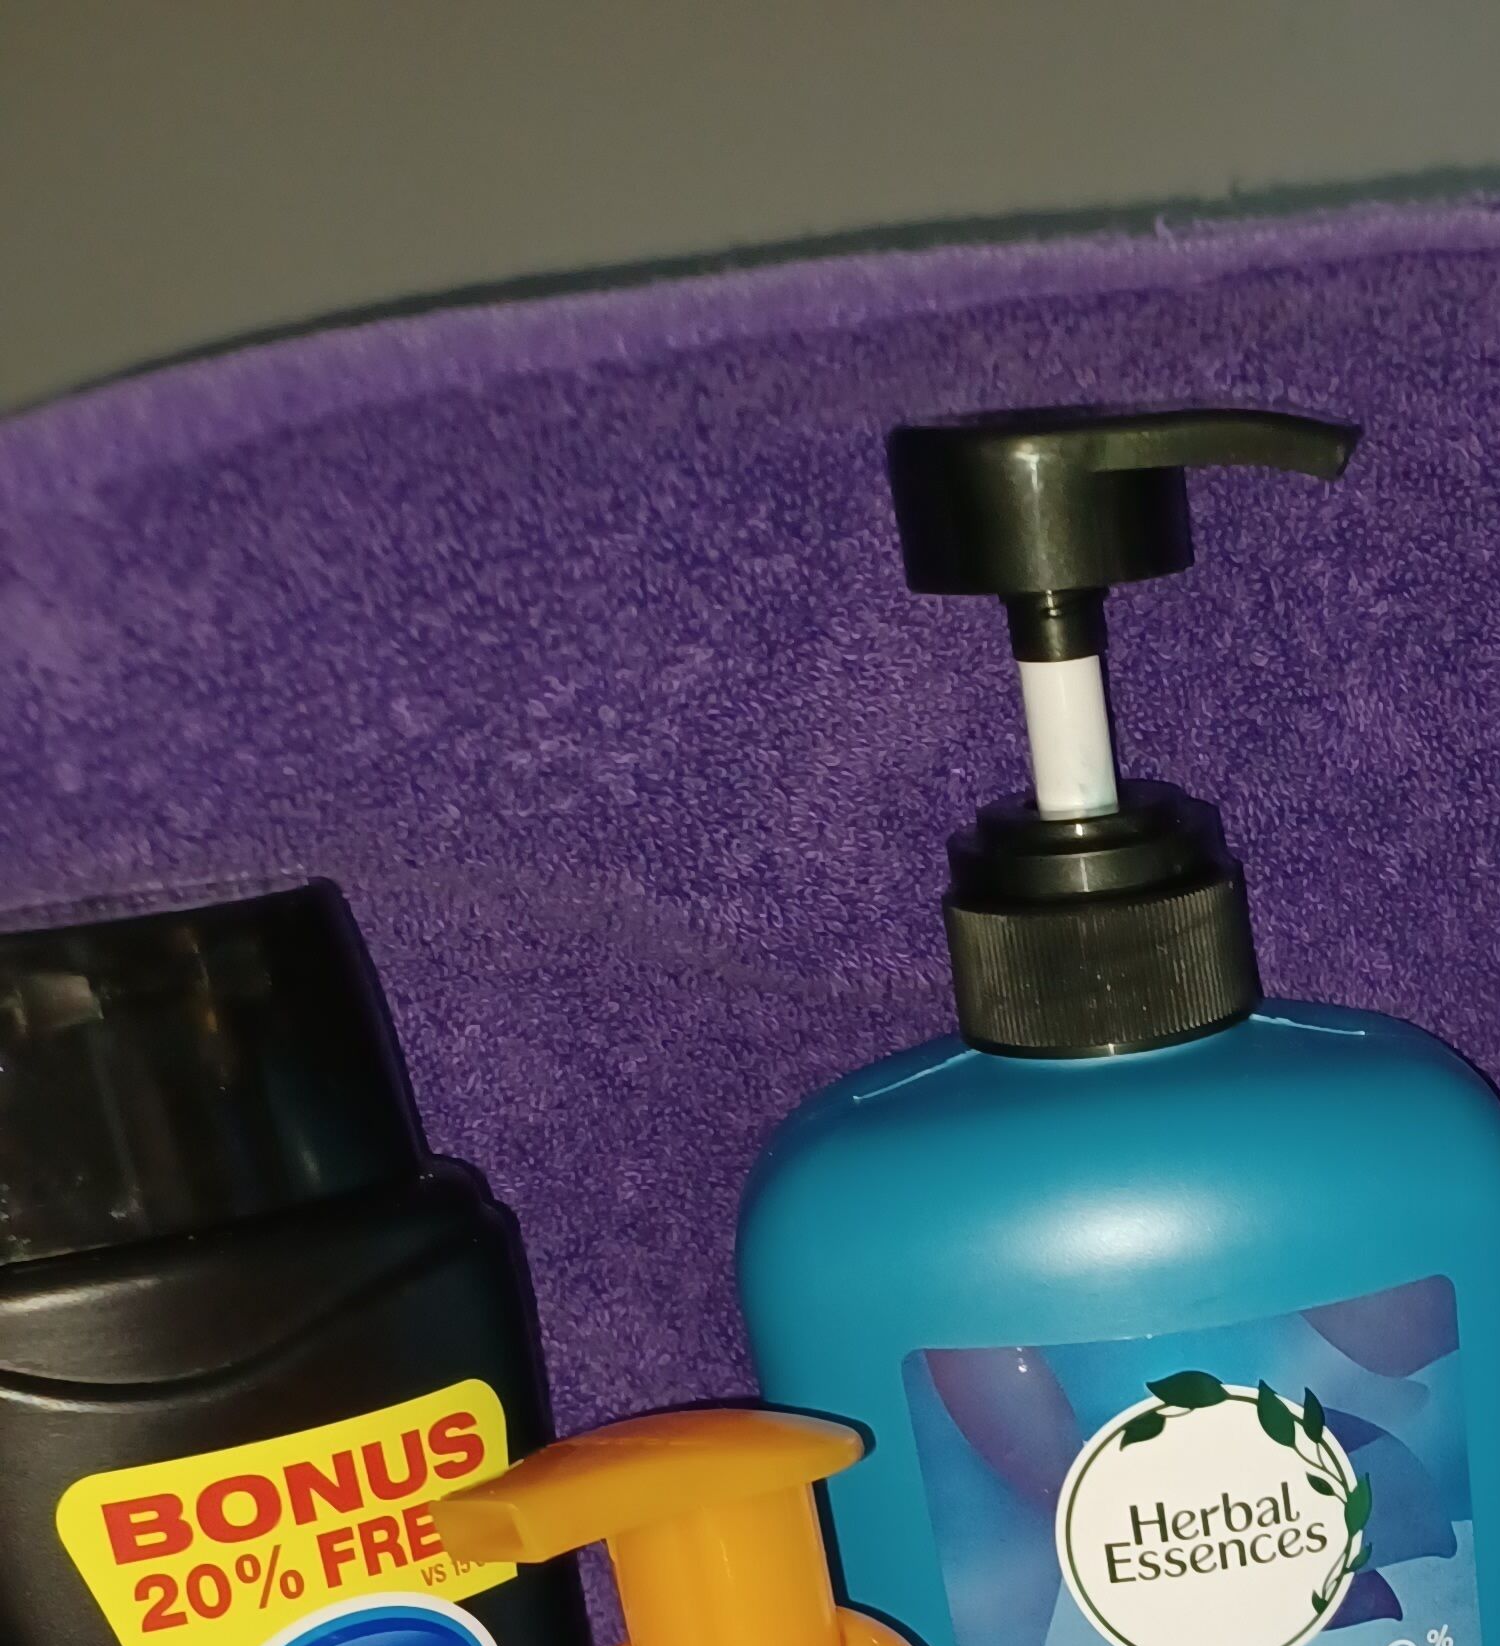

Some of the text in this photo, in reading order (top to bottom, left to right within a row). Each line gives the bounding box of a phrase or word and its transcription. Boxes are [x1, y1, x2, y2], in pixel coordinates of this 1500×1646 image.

[101, 1412, 485, 1565] BONUS
[1129, 1482, 1301, 1546] Herbal
[134, 1500, 446, 1632] 20% FRE
[421, 1564, 447, 1586] VS
[1104, 1520, 1329, 1584] Essences
